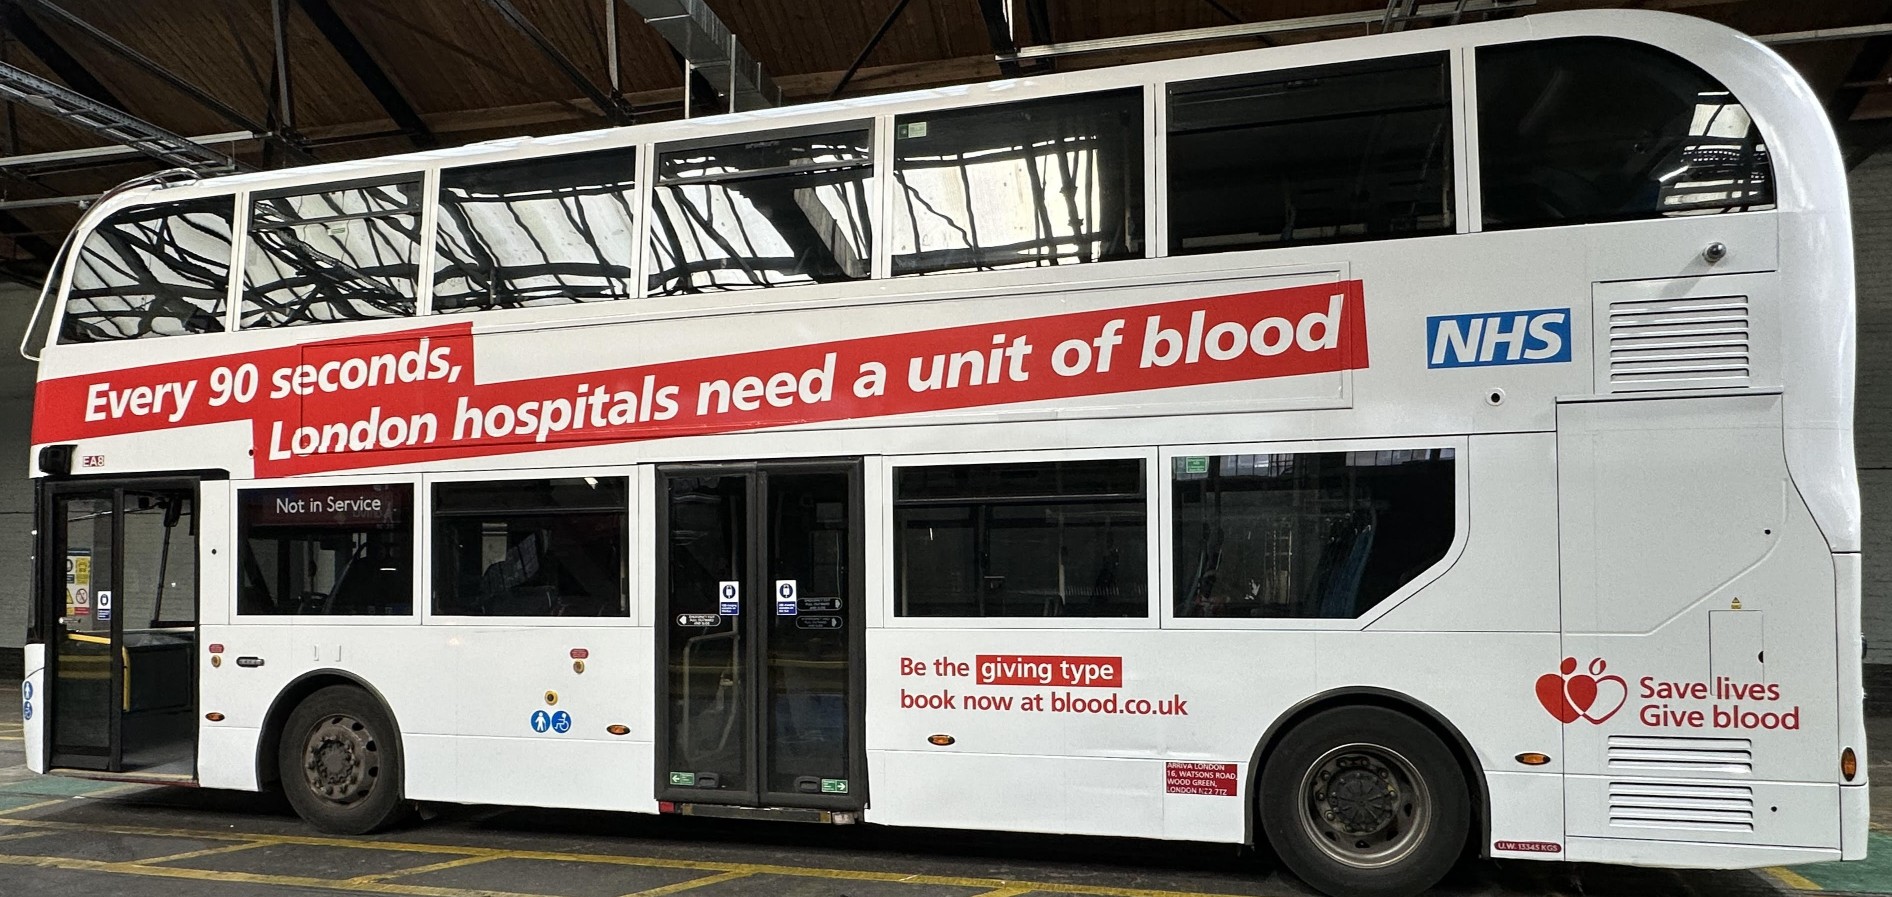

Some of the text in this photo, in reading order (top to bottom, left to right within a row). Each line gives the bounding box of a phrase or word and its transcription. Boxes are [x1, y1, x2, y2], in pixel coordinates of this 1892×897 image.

[1431, 312, 1565, 364] NHS
[84, 336, 463, 422] Every 90 seconds,
[268, 293, 1345, 461] London hospitals need a unit of blood
[83, 456, 104, 467] EA8
[276, 496, 381, 513] Not in Service
[900, 657, 1114, 686] Be the giving type
[1639, 676, 1780, 701] Save lives
[900, 689, 1188, 716] book now at blood.co.uk
[1639, 704, 1799, 730] Give blood
[1167, 770, 1177, 778] 16,
[1192, 779, 1218, 787] GREEN,
